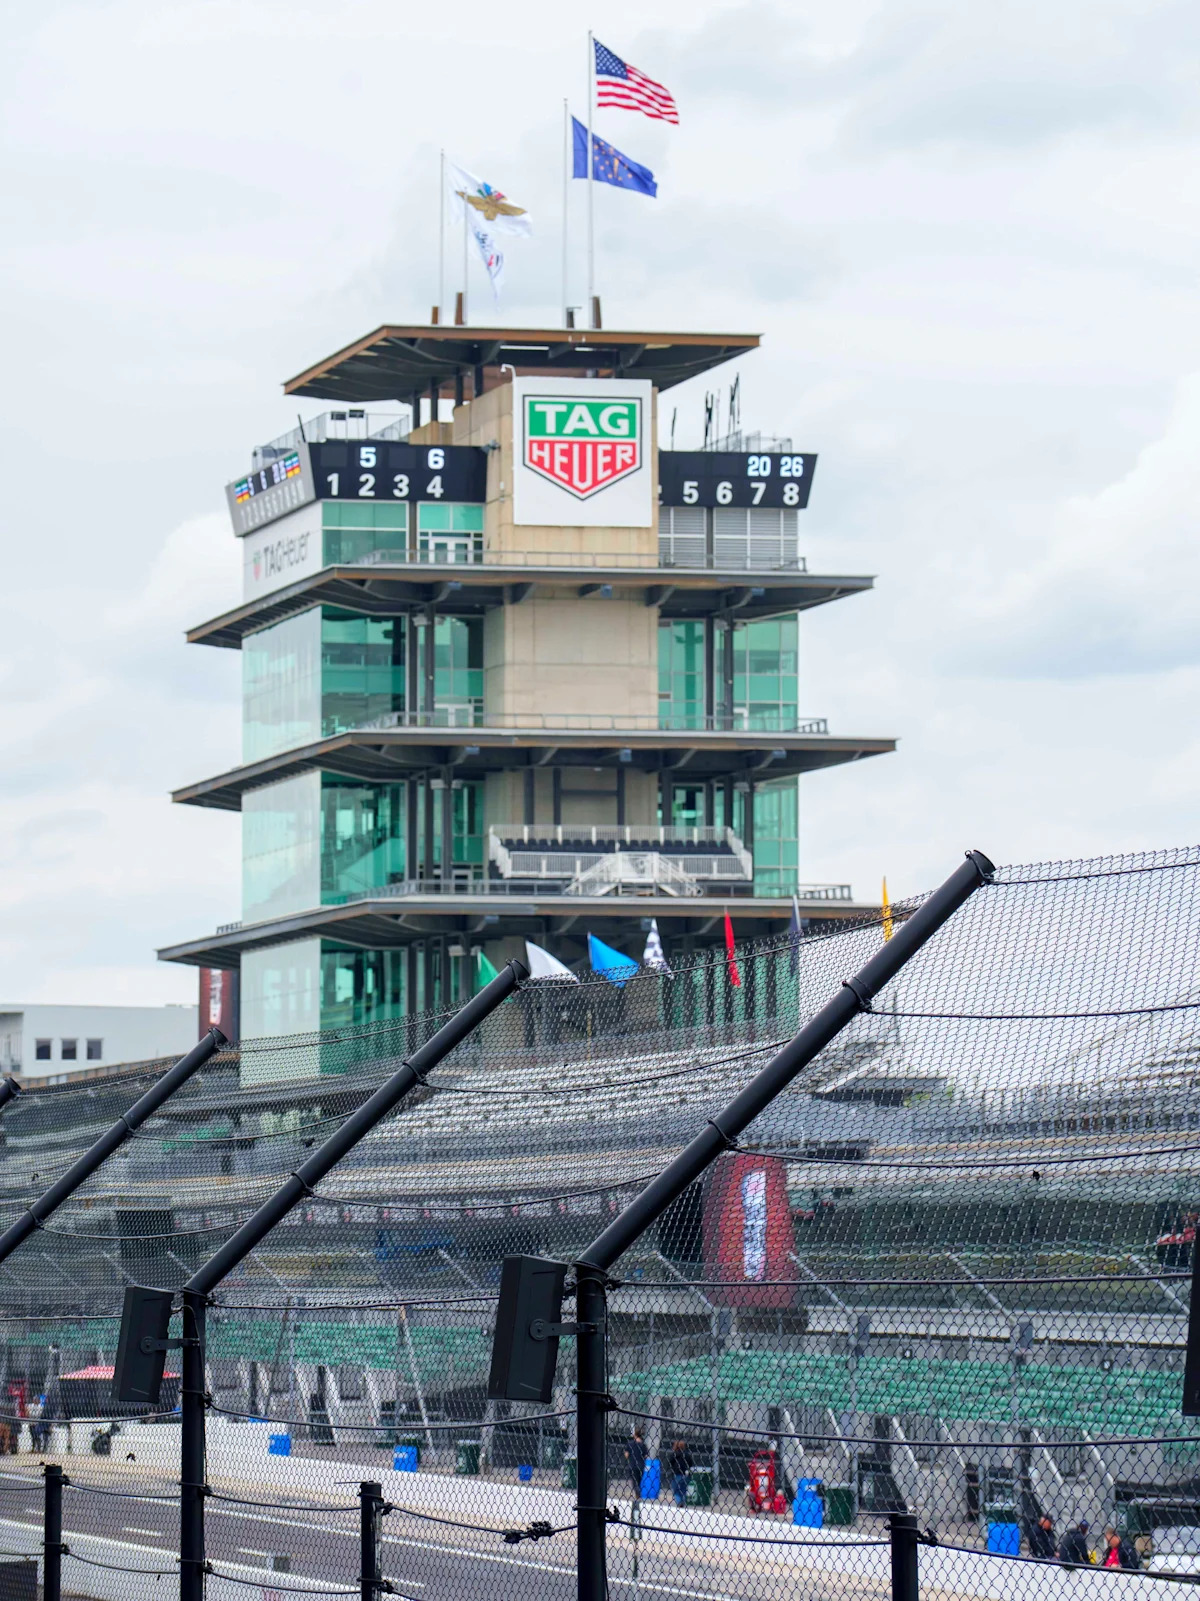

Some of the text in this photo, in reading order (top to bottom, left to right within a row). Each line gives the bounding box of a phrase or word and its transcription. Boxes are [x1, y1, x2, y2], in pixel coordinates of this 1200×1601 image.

[534, 403, 630, 436] TAG
[359, 446, 445, 470] 5 6
[531, 442, 634, 490] HEUER
[747, 455, 804, 477] 20 26
[326, 472, 340, 496] 1
[358, 473, 376, 497] 2
[392, 474, 410, 498] 3
[426, 475, 444, 499] 4
[683, 480, 700, 505] 5
[716, 481, 733, 505] 6
[750, 482, 767, 505] 7
[782, 482, 800, 506] 8
